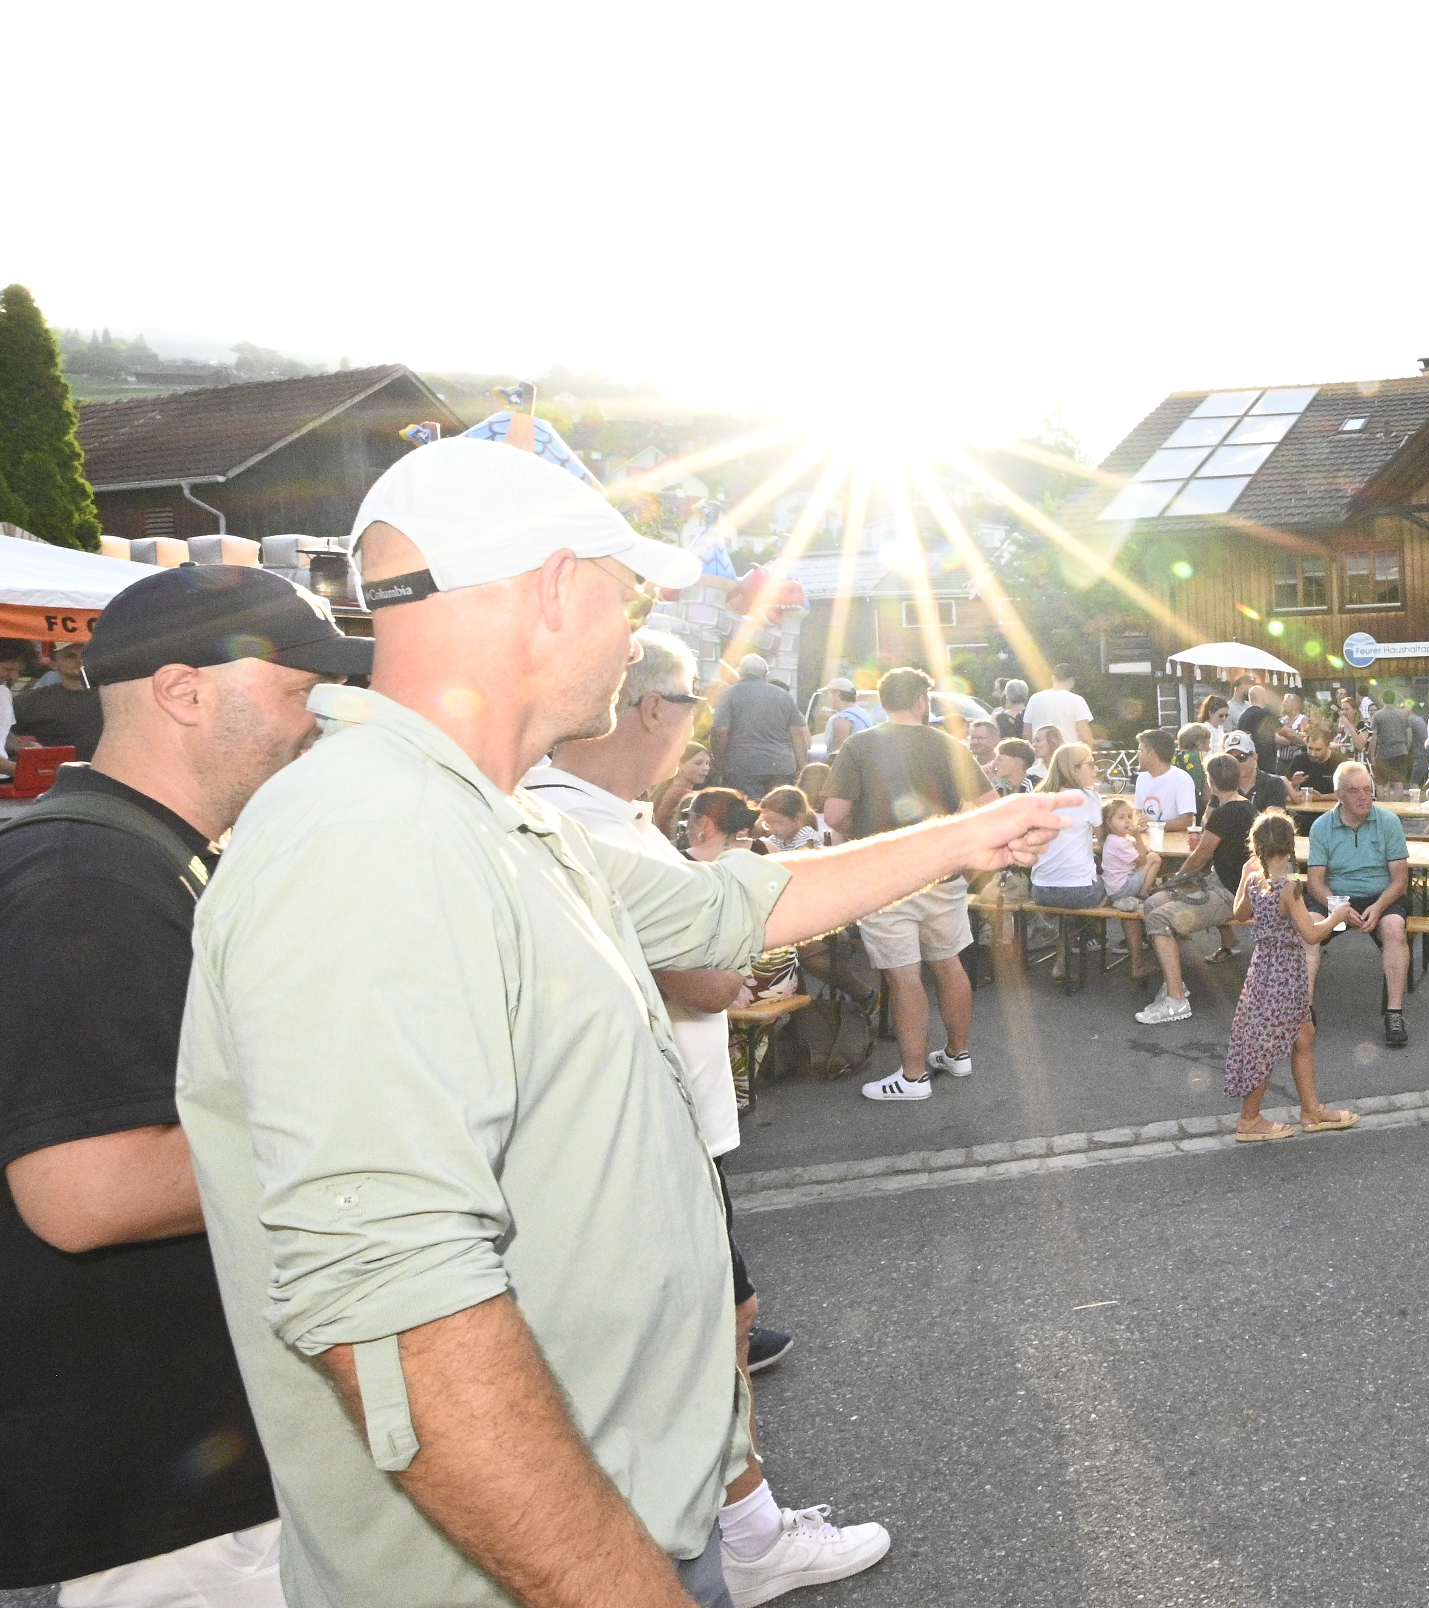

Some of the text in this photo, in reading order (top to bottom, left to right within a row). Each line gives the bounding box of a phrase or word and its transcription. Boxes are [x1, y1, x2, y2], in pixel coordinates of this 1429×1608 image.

[369, 585, 413, 601] Columbia
[45, 615, 78, 633] FC
[1355, 647, 1381, 655] Feurer
